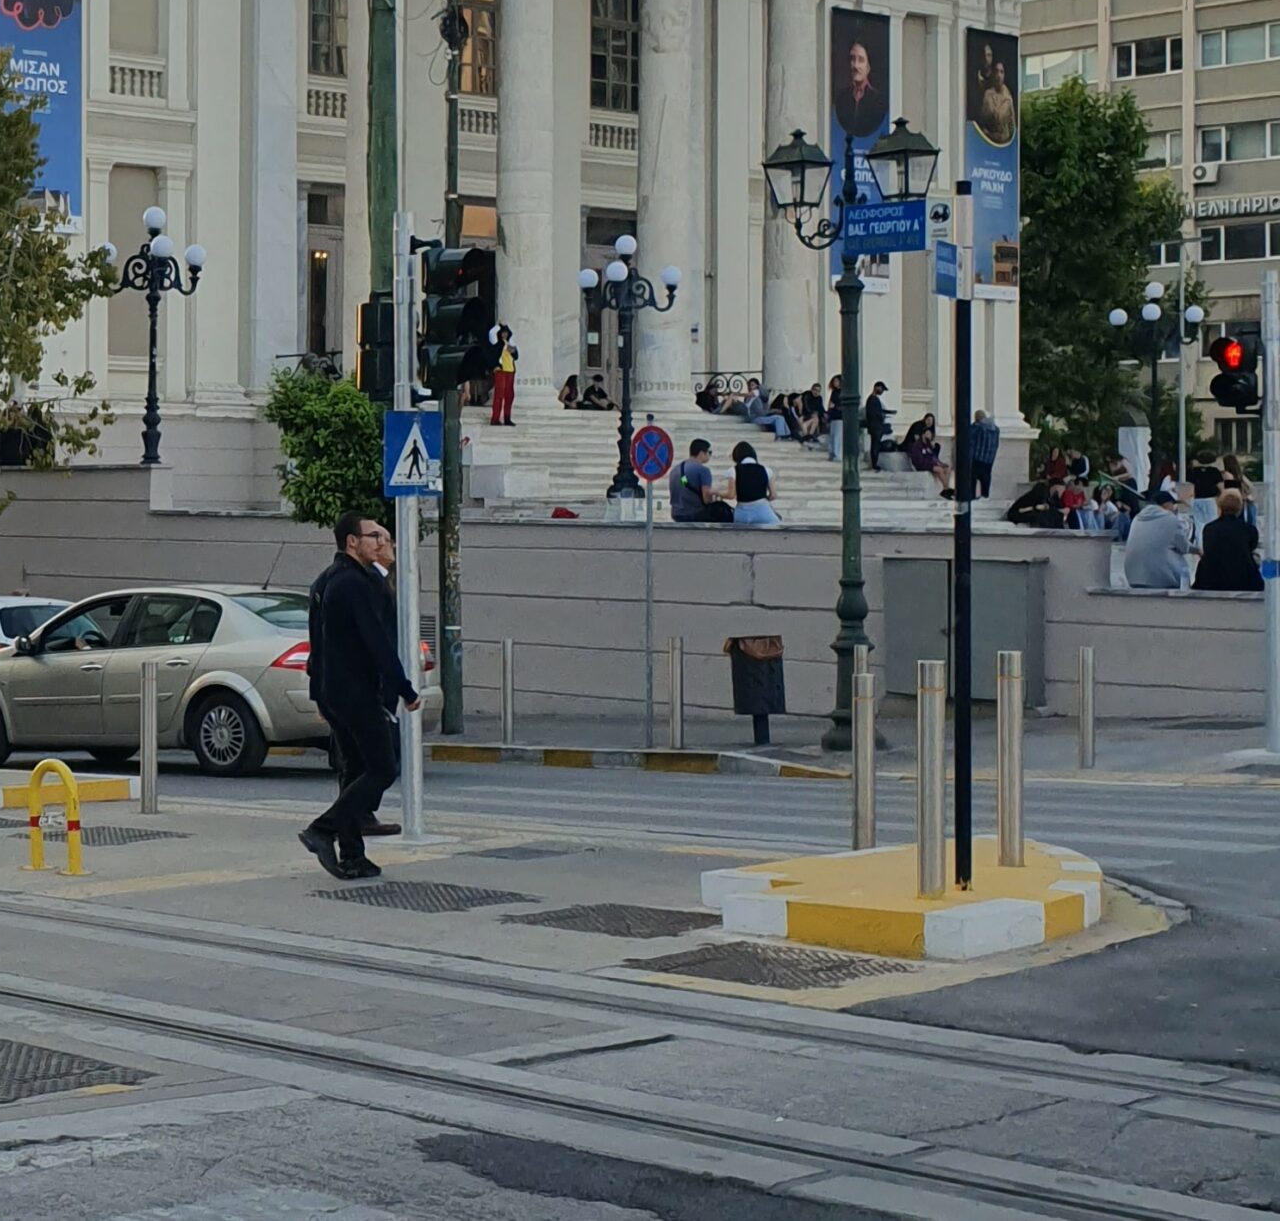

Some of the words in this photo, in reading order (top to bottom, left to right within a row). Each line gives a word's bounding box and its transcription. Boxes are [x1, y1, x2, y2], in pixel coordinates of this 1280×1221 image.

[10, 58, 60, 77] ΜΙΣΑΝ
[971, 167, 1013, 183] ΑΡΚΟΥΔΟ
[847, 205, 905, 221] ΛΕΩΦΟΡΟΣ
[869, 218, 912, 235] ΓΕΩΡΓΙΟΥ
